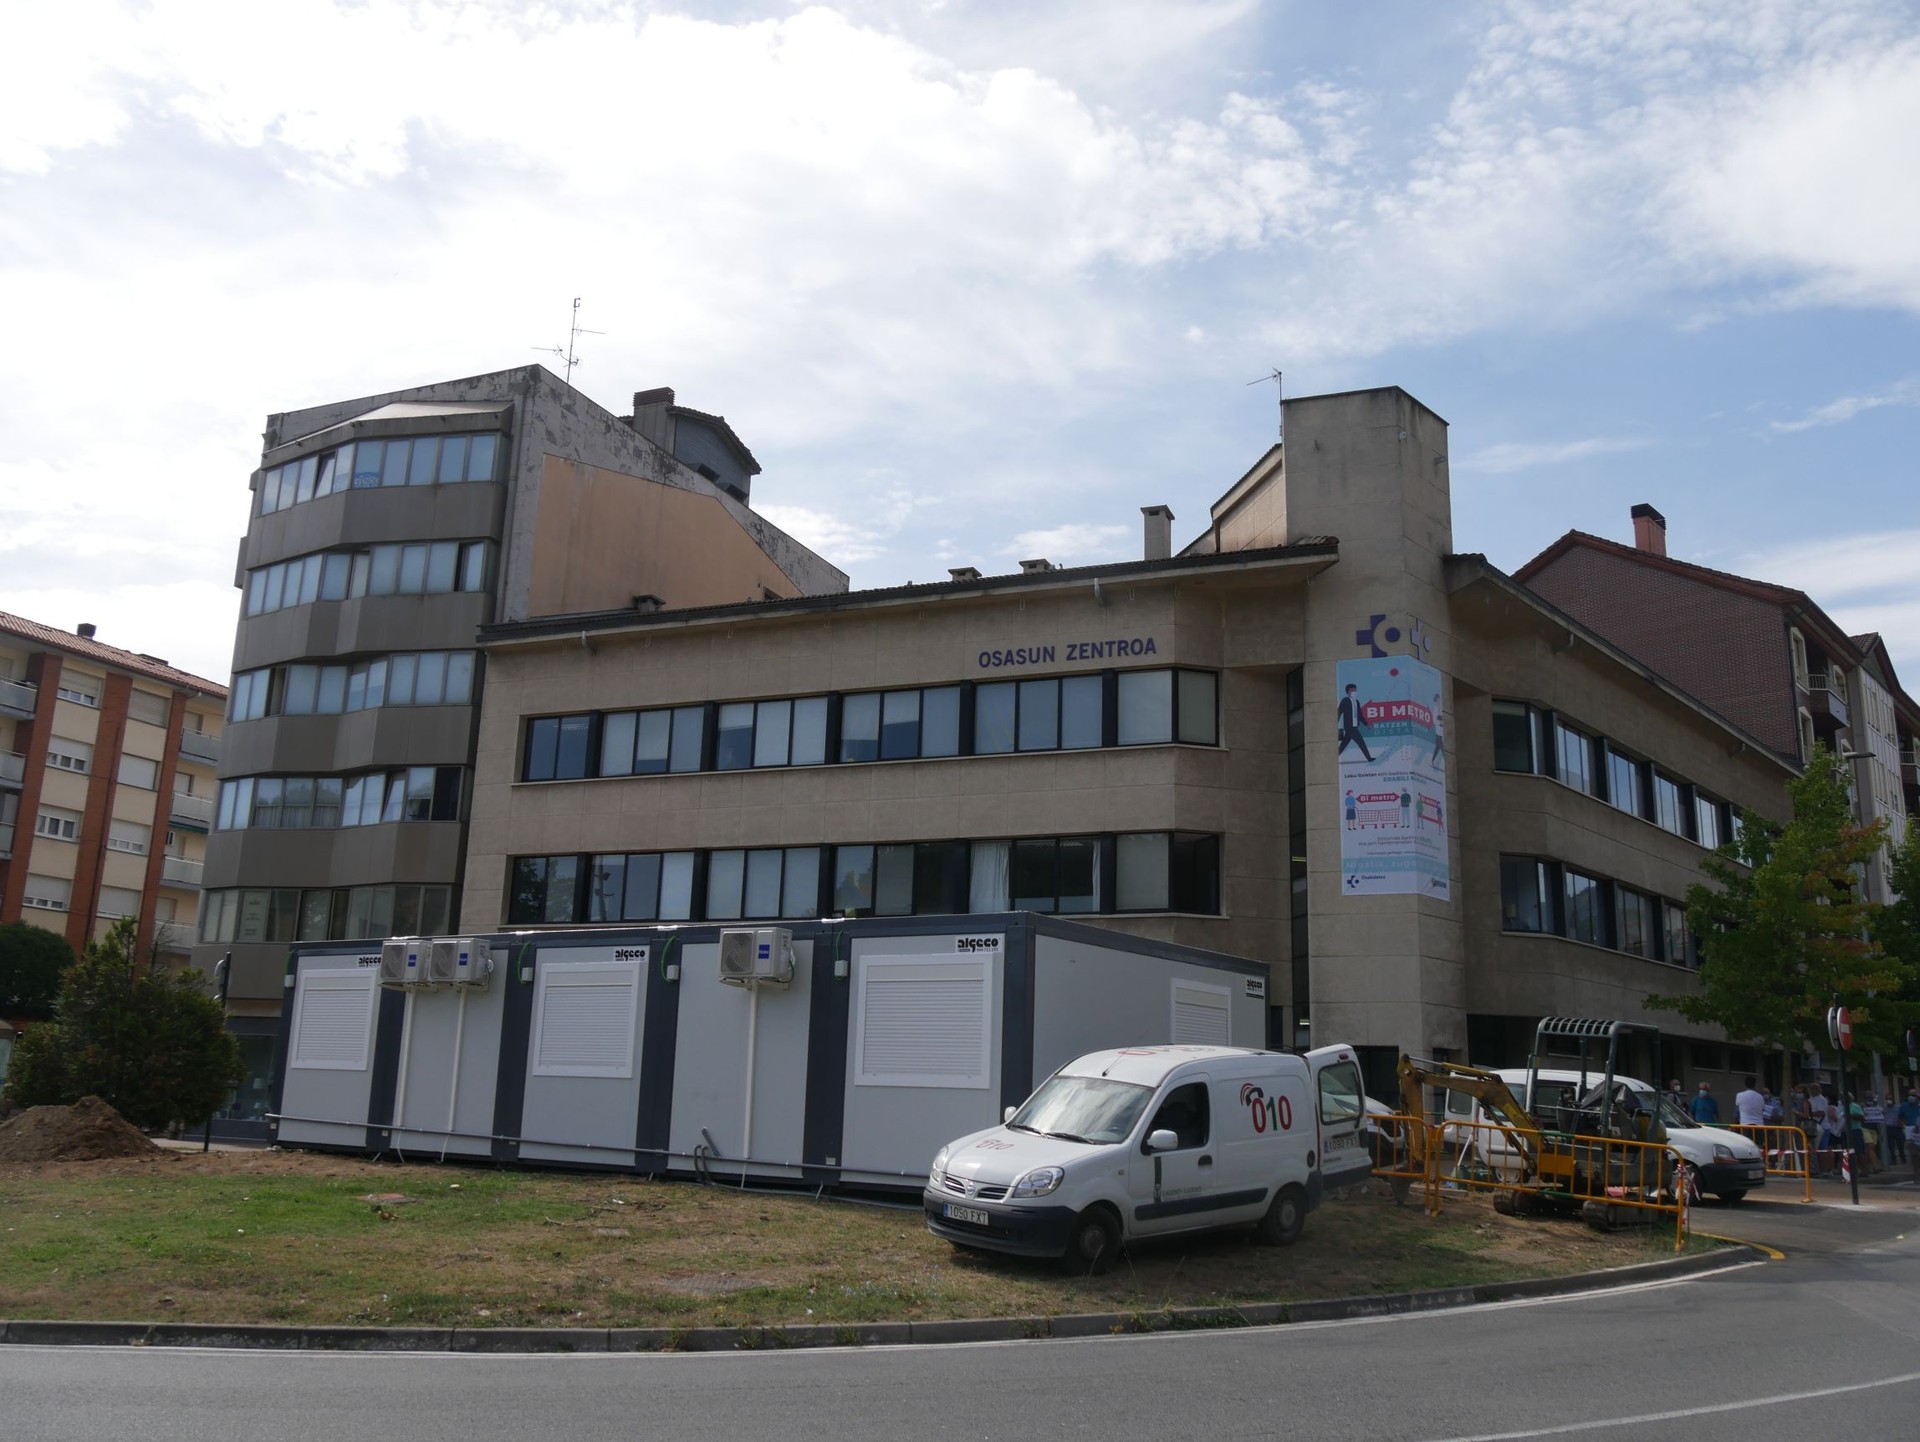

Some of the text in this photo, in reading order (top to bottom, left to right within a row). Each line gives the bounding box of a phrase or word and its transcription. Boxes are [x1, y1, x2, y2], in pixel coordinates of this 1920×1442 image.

[978, 637, 1157, 668] OSASUN ZENTROA
[1366, 705, 1431, 722] BI METRO
[957, 937, 999, 953] algeco
[614, 949, 646, 962] algeco
[1251, 1095, 1292, 1134] 010
[949, 1205, 987, 1224] 1090 FXT
